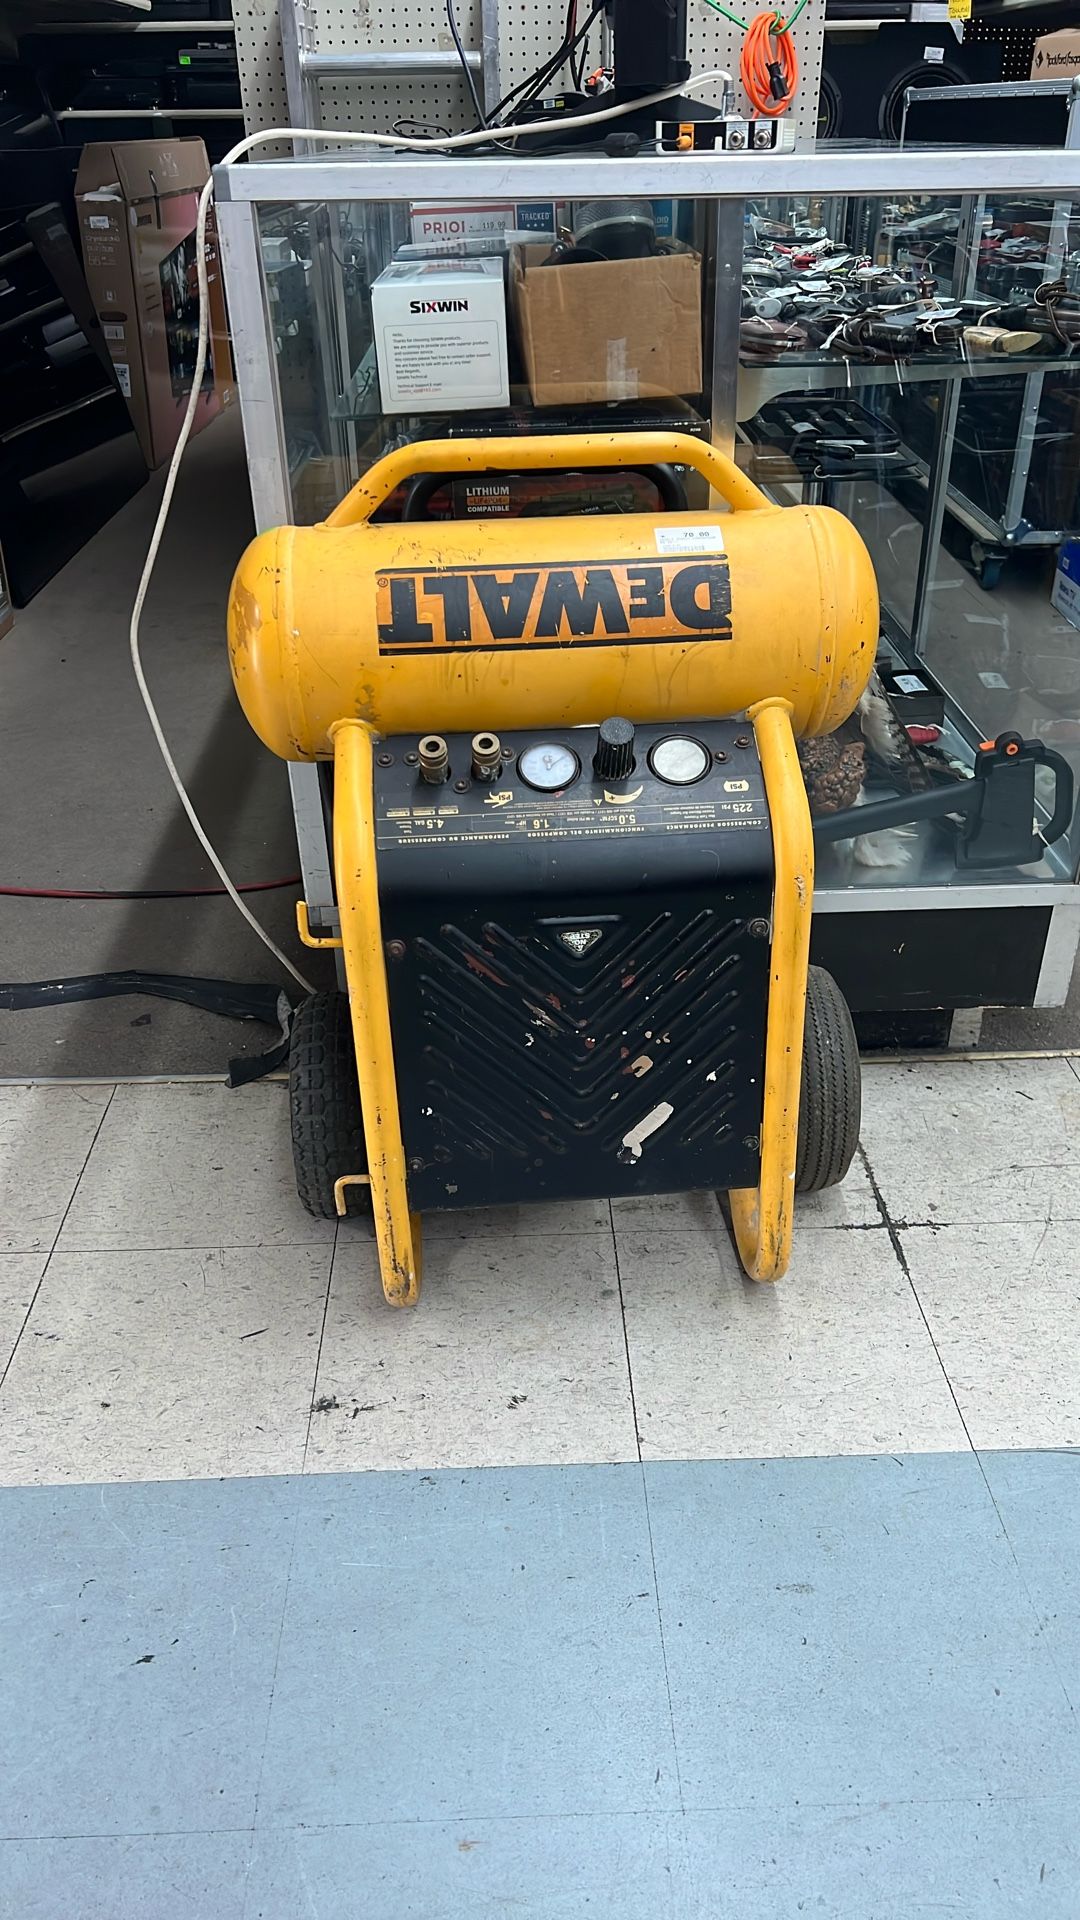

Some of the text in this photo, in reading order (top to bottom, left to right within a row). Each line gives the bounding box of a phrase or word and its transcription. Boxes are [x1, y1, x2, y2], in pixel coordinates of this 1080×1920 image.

[466, 486, 510, 497] LITHIUM
[467, 505, 510, 513] COMPATIBLE
[732, 803, 753, 814] 225
[426, 819, 444, 829] 4.5
[533, 819, 550, 829] 1.6
[619, 814, 636, 825] 5.0
[585, 826, 645, 835] FUNCIONAMIENTO
[666, 822, 715, 831] PERFORMANCE
[398, 837, 446, 845] COMPRESSEUR
[461, 833, 510, 842] PERFORMANCE
